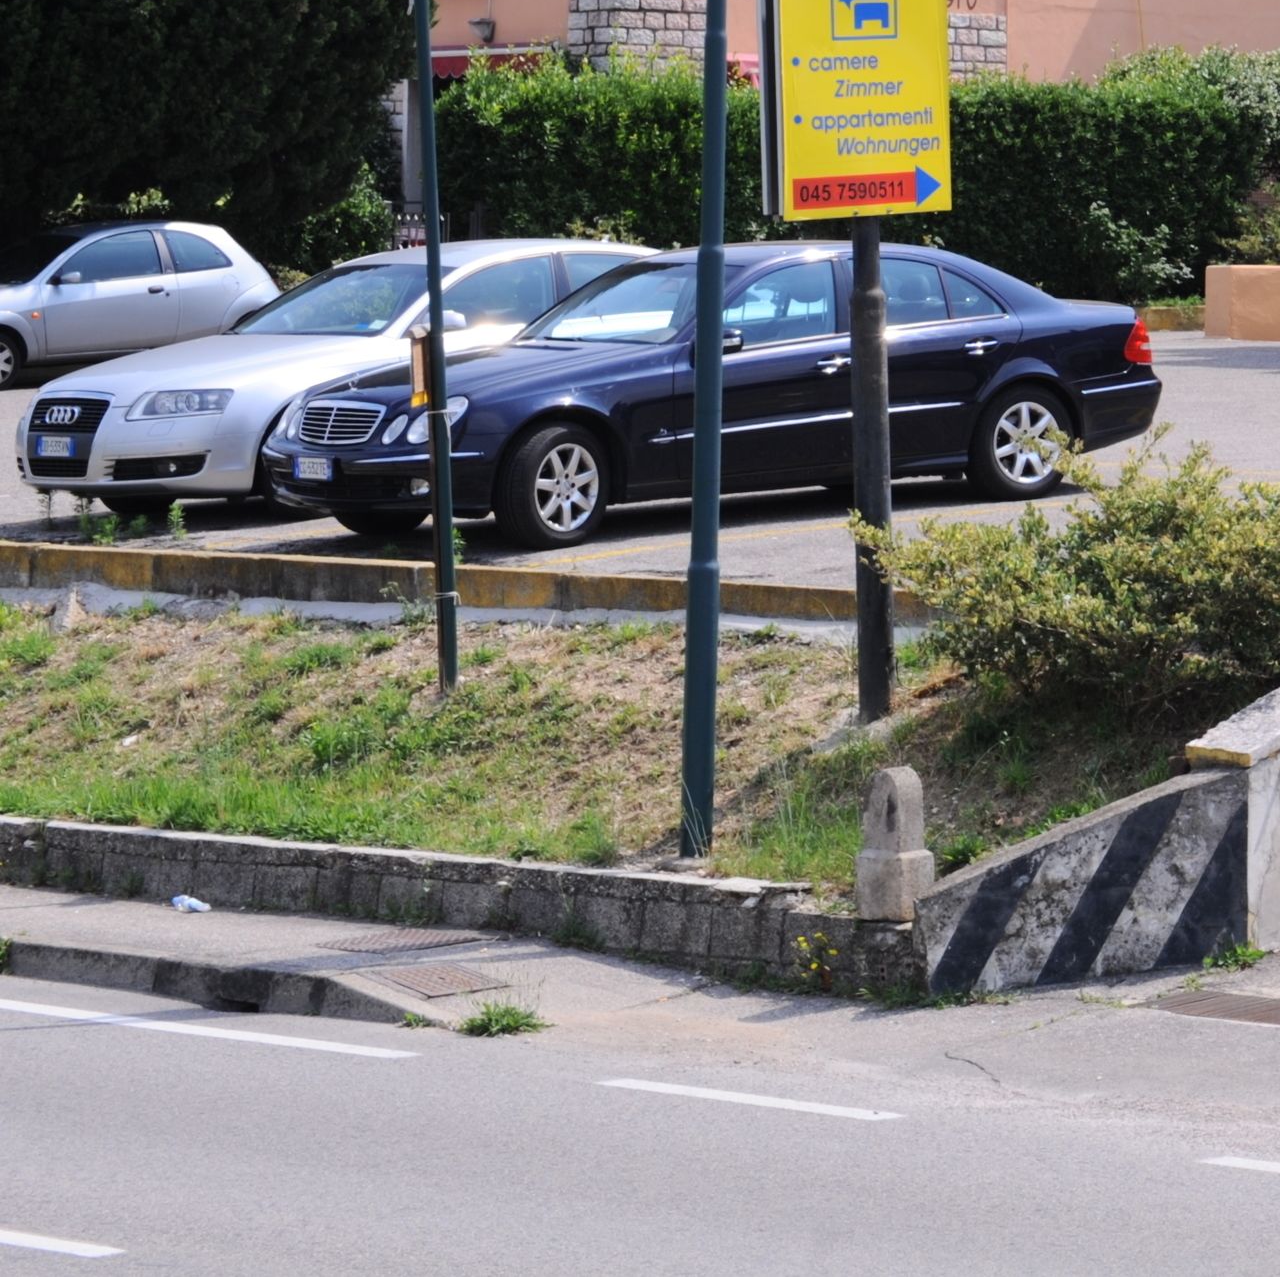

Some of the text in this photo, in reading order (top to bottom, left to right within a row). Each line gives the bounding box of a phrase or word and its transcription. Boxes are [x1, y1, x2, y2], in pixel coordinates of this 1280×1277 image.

[808, 55, 879, 72] camere
[834, 79, 903, 98] Zimmer
[811, 107, 934, 133] appartamenti
[837, 136, 941, 158] Wohnungen
[800, 180, 905, 203] 045 7590511
